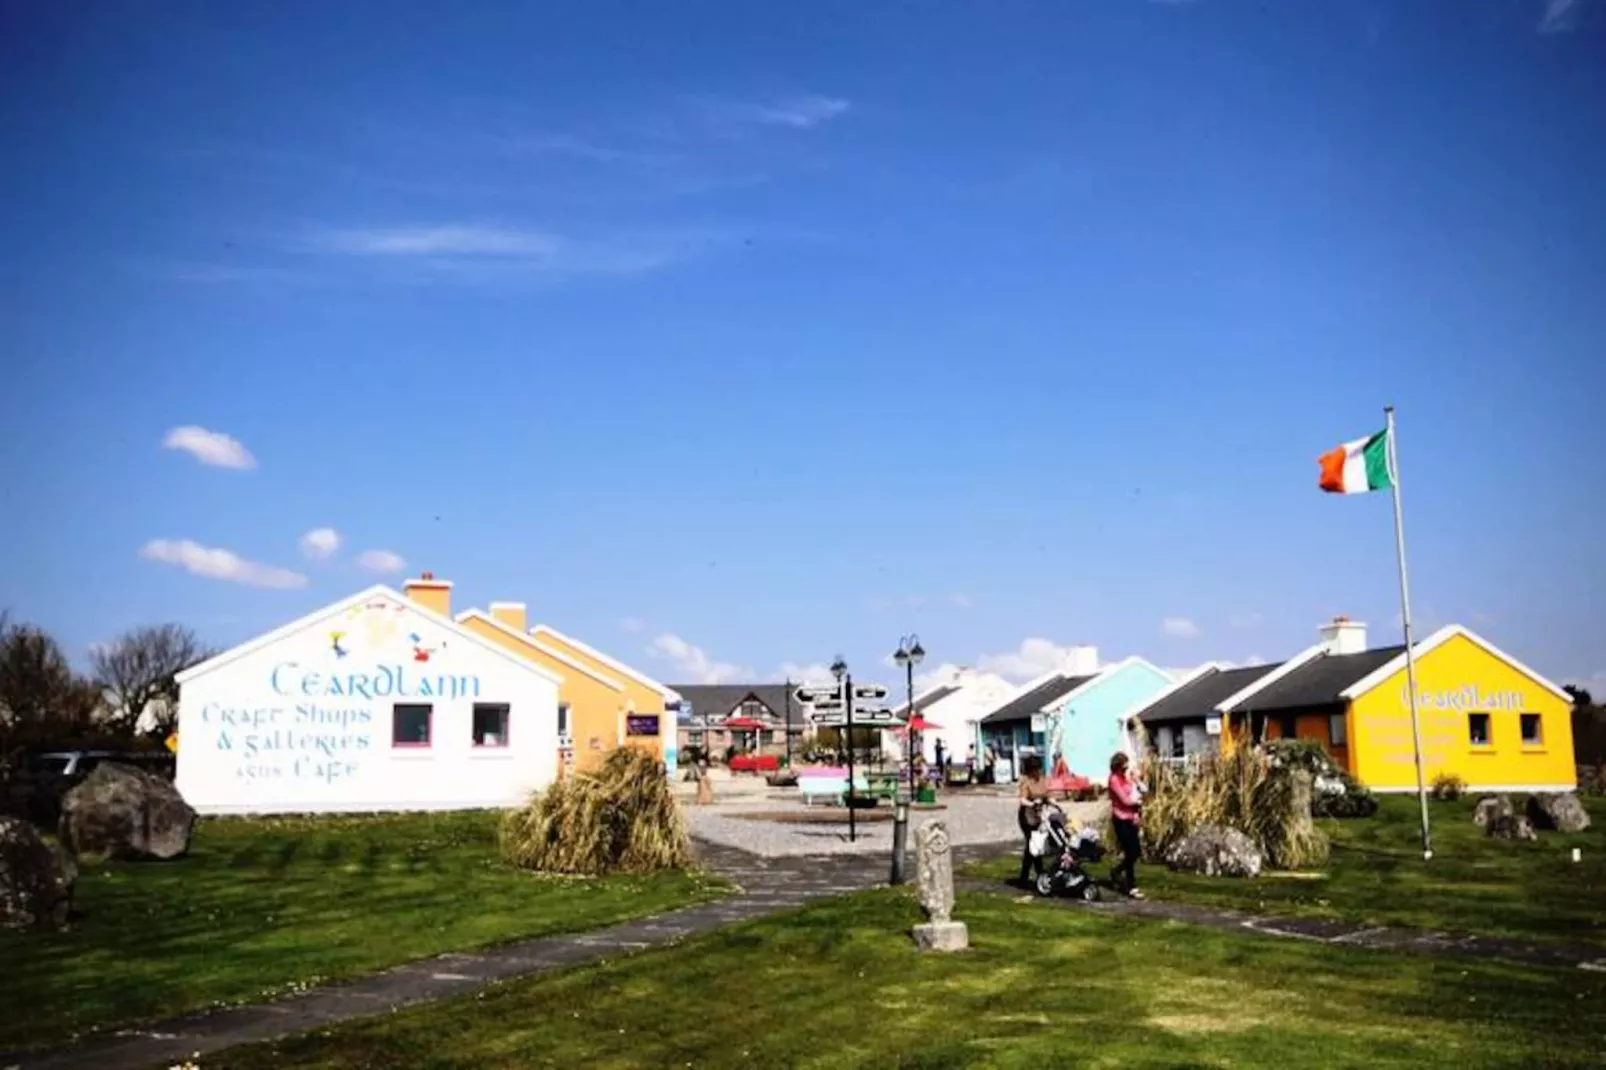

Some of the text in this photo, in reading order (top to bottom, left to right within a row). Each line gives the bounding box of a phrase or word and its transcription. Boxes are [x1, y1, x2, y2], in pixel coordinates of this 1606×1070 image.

[201, 702, 372, 729] Craft Shops
[216, 730, 233, 750] &
